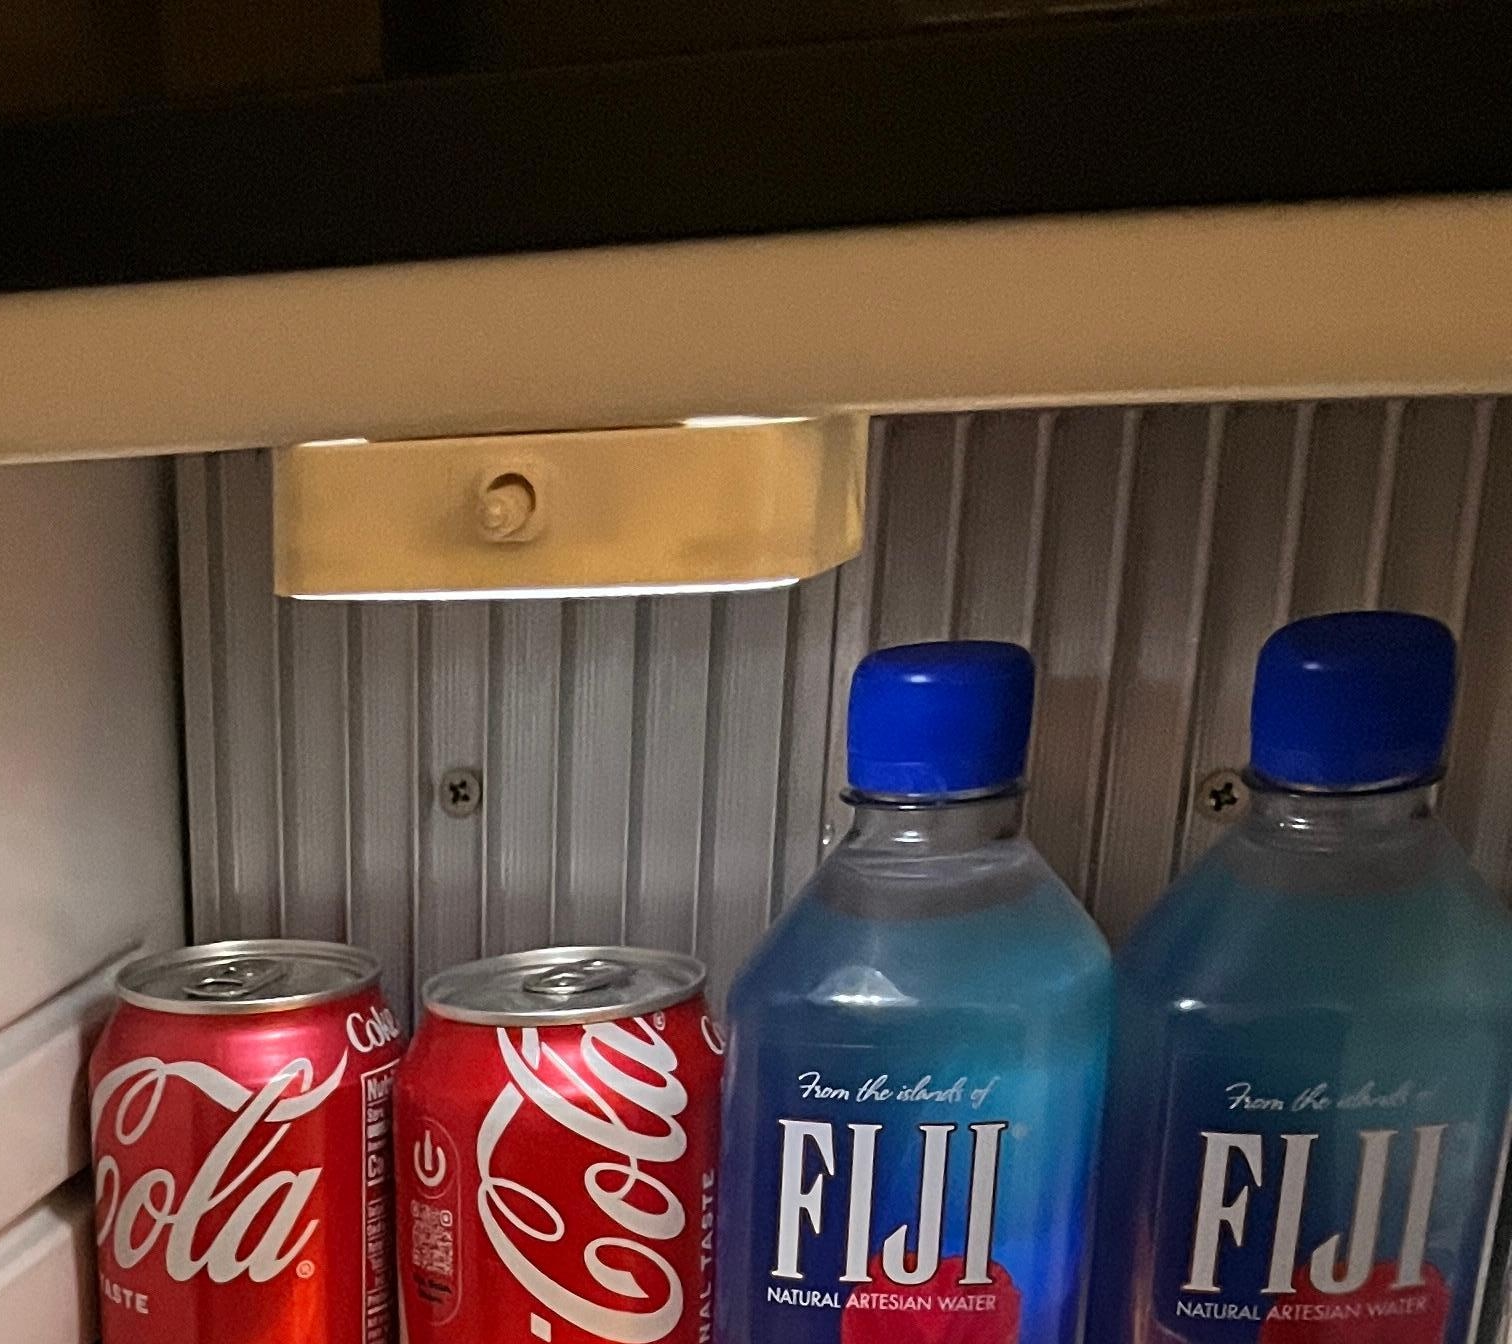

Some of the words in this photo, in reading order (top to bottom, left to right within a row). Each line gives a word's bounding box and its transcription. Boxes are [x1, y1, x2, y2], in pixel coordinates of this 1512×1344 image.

[798, 1071, 850, 1100] From
[855, 1074, 893, 1102] the
[896, 1074, 967, 1103] islands
[970, 1075, 1001, 1110] of
[1225, 1082, 1284, 1110] From
[1291, 1082, 1330, 1112] the
[700, 1168, 714, 1273] TASTE
[772, 1118, 1007, 1285] FIJI
[1180, 1124, 1449, 1294] FIJI
[767, 1286, 842, 1309] NATURAL
[846, 1292, 933, 1311] ARTESIAN
[936, 1294, 997, 1311] WATER
[1175, 1300, 1262, 1321] NATURAL
[1265, 1302, 1362, 1321] ARTESIAN
[1365, 1296, 1432, 1320] WATER
